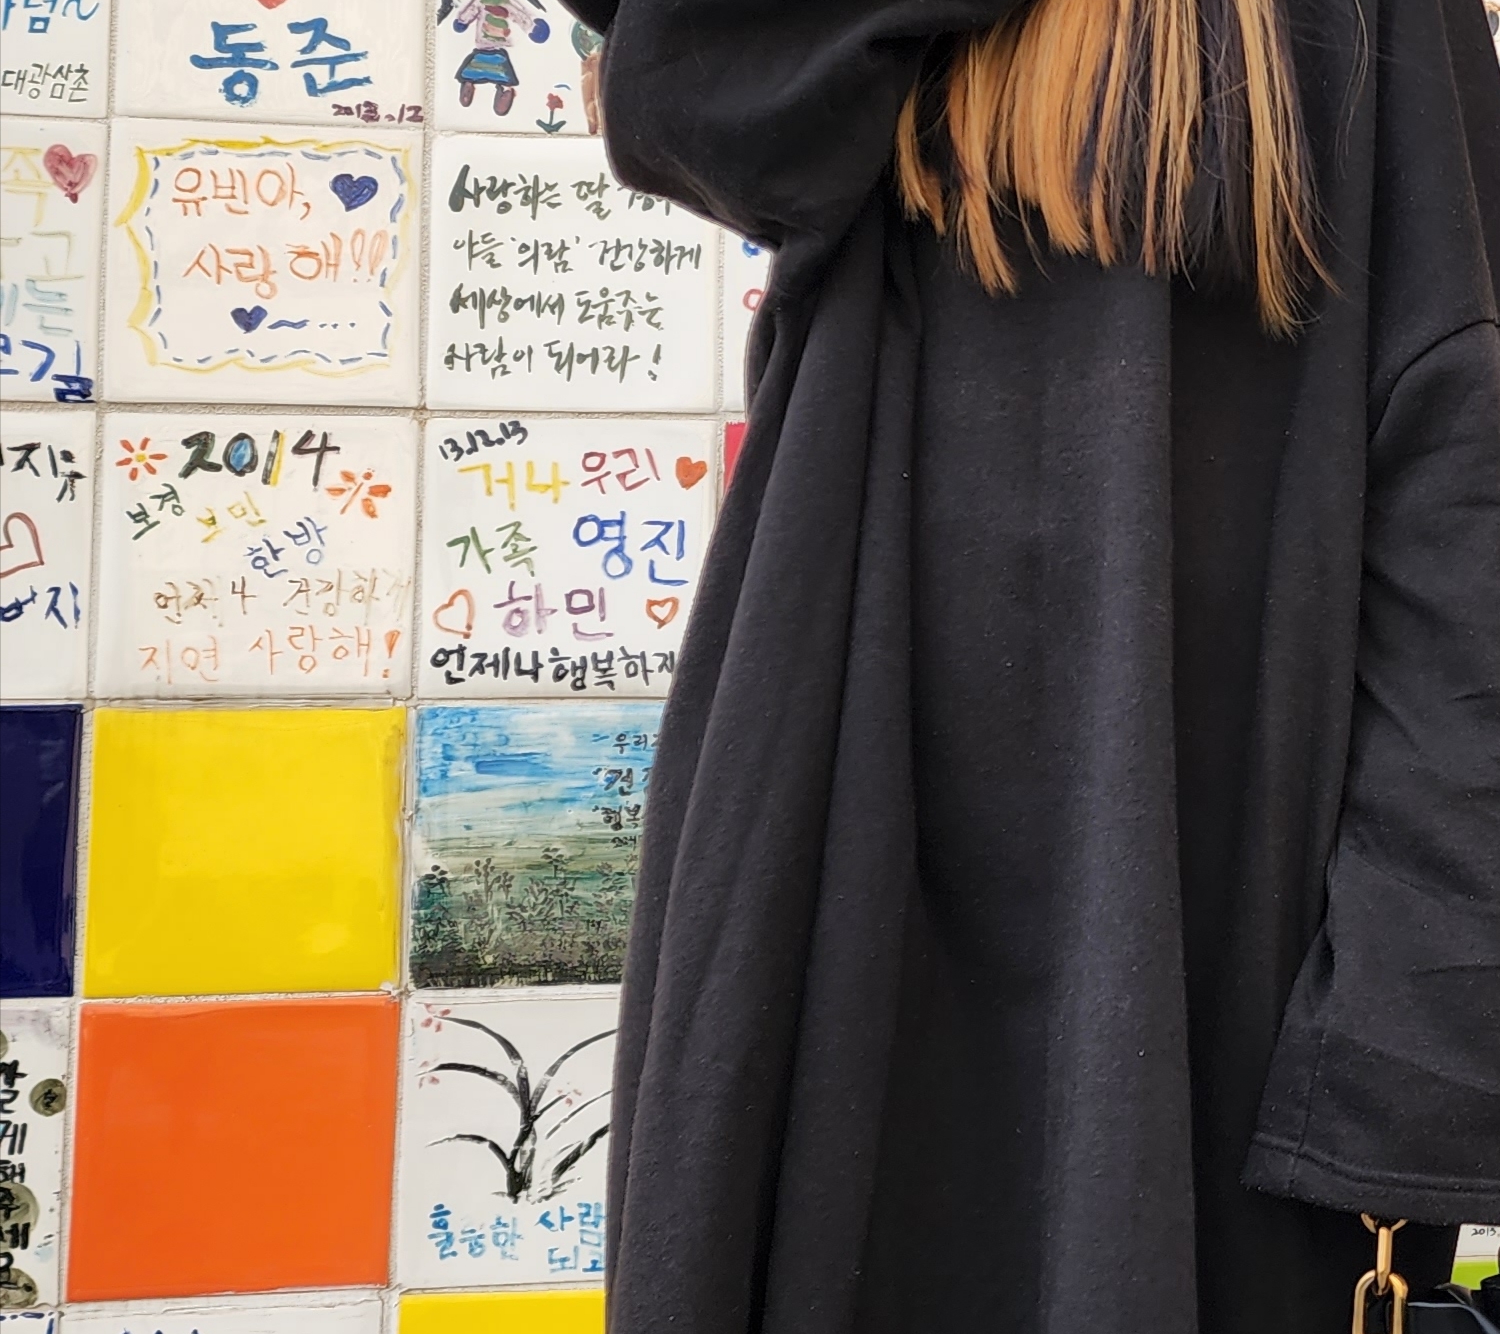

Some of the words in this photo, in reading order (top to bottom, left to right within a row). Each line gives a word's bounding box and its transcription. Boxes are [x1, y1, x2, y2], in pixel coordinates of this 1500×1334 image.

[190, 17, 373, 108] 동준
[172, 162, 312, 220] 유빈아,
[449, 164, 562, 221] 사랑하는
[571, 173, 612, 221] 딸
[454, 229, 504, 271] 아들
[589, 237, 702, 276] 건강하게
[449, 282, 565, 330] 세상에서
[444, 335, 533, 380] 사람이
[178, 429, 341, 489] 2014
[581, 448, 661, 495] 우리
[446, 521, 538, 577] 가족
[573, 510, 689, 586] 영진
[493, 580, 614, 642] 하민
